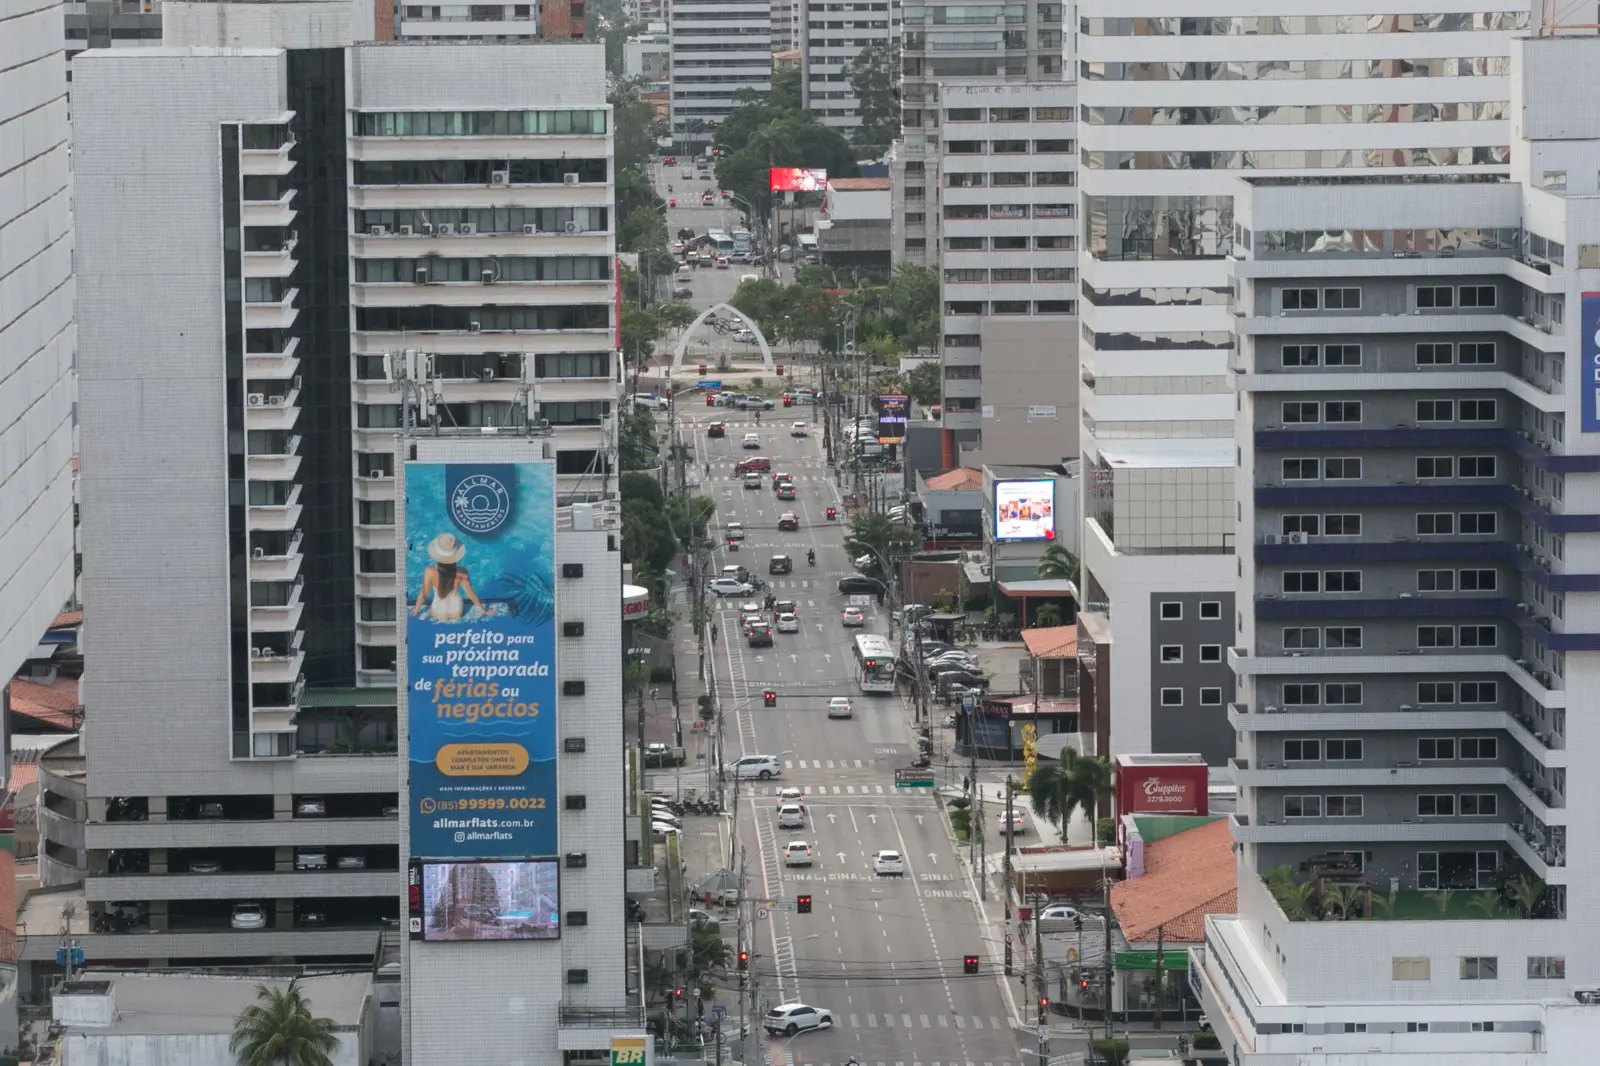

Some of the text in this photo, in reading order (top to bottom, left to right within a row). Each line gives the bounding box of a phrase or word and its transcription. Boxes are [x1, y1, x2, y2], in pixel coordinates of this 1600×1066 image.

[458, 477, 503, 496] ALLMAR
[456, 509, 505, 529] APARTAMENTOS
[435, 629, 534, 647] perfeito para
[422, 648, 519, 664] sua próxima
[452, 662, 549, 681] temporada
[415, 678, 520, 703] de férias ou
[437, 699, 539, 723] negócios
[433, 818, 534, 829] allmarflats.com.br
[467, 832, 513, 840] allmarflats
[616, 1050, 643, 1063] BR
